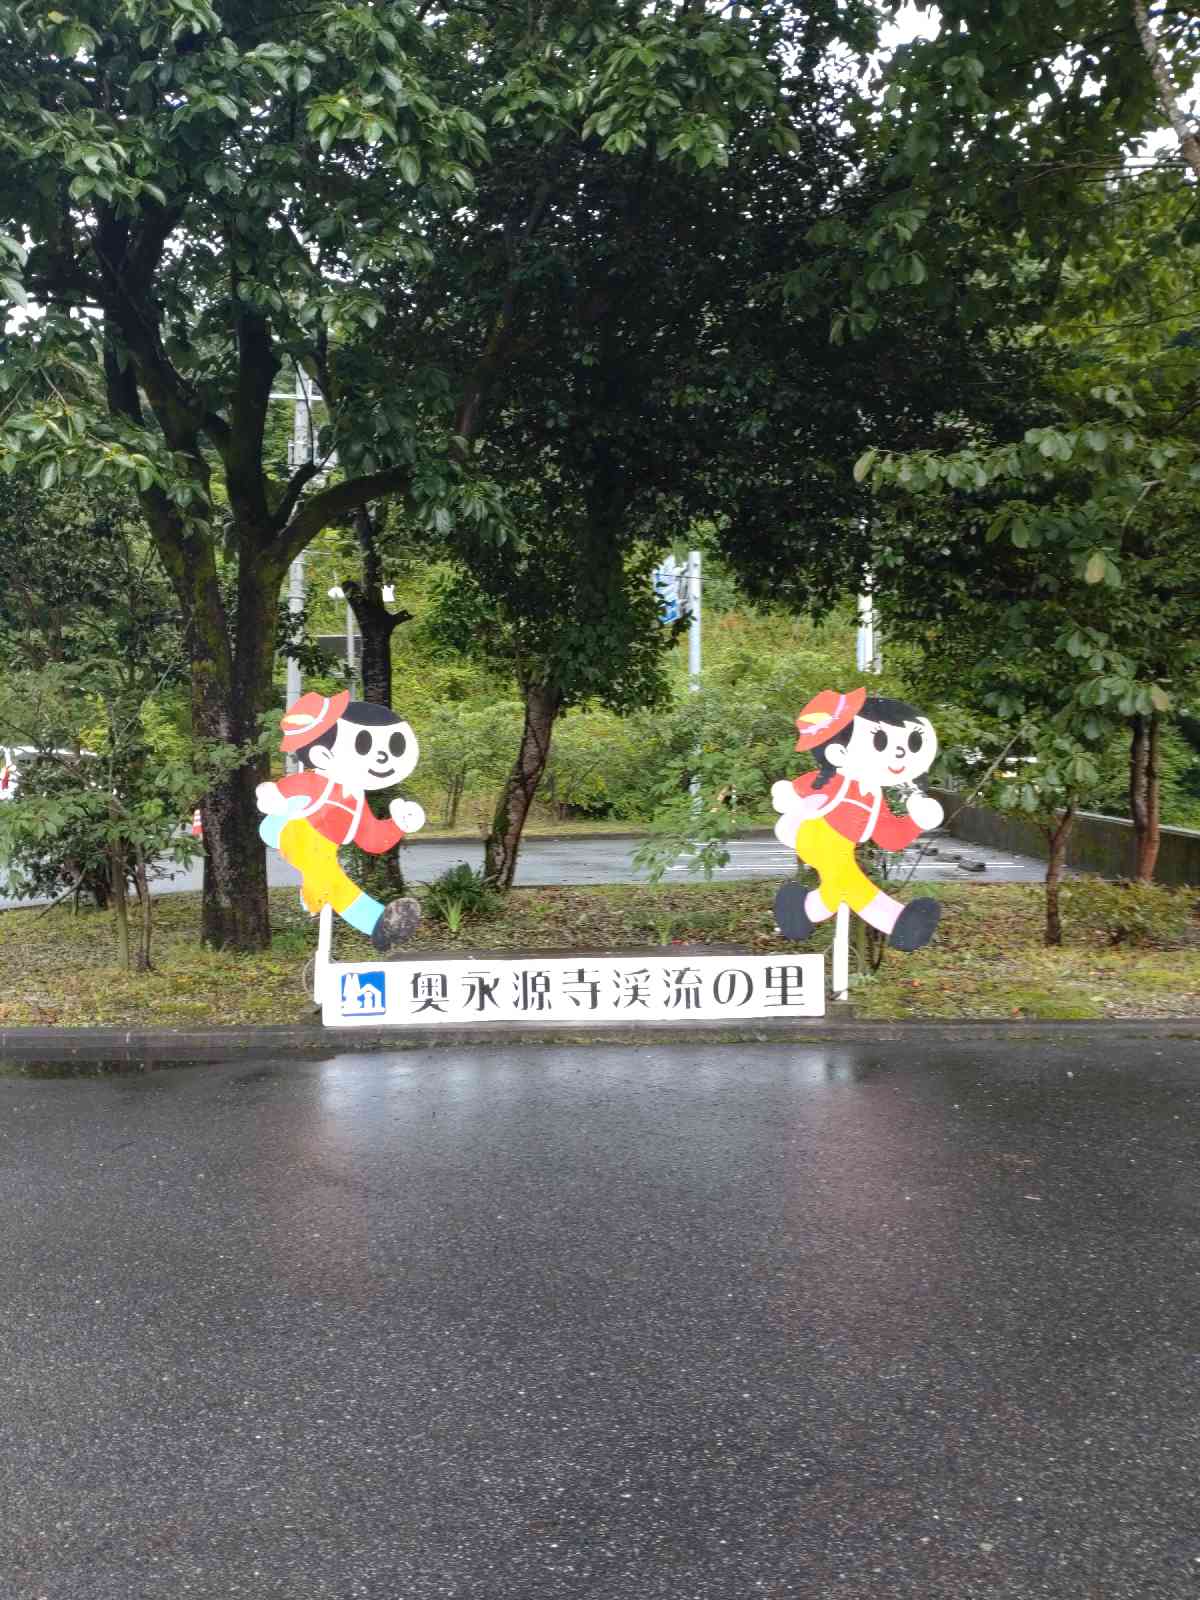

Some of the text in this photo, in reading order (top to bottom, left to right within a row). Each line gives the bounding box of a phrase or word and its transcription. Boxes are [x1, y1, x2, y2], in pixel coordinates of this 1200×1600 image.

[410, 965, 805, 1013] 奥永源寺渓流の里
